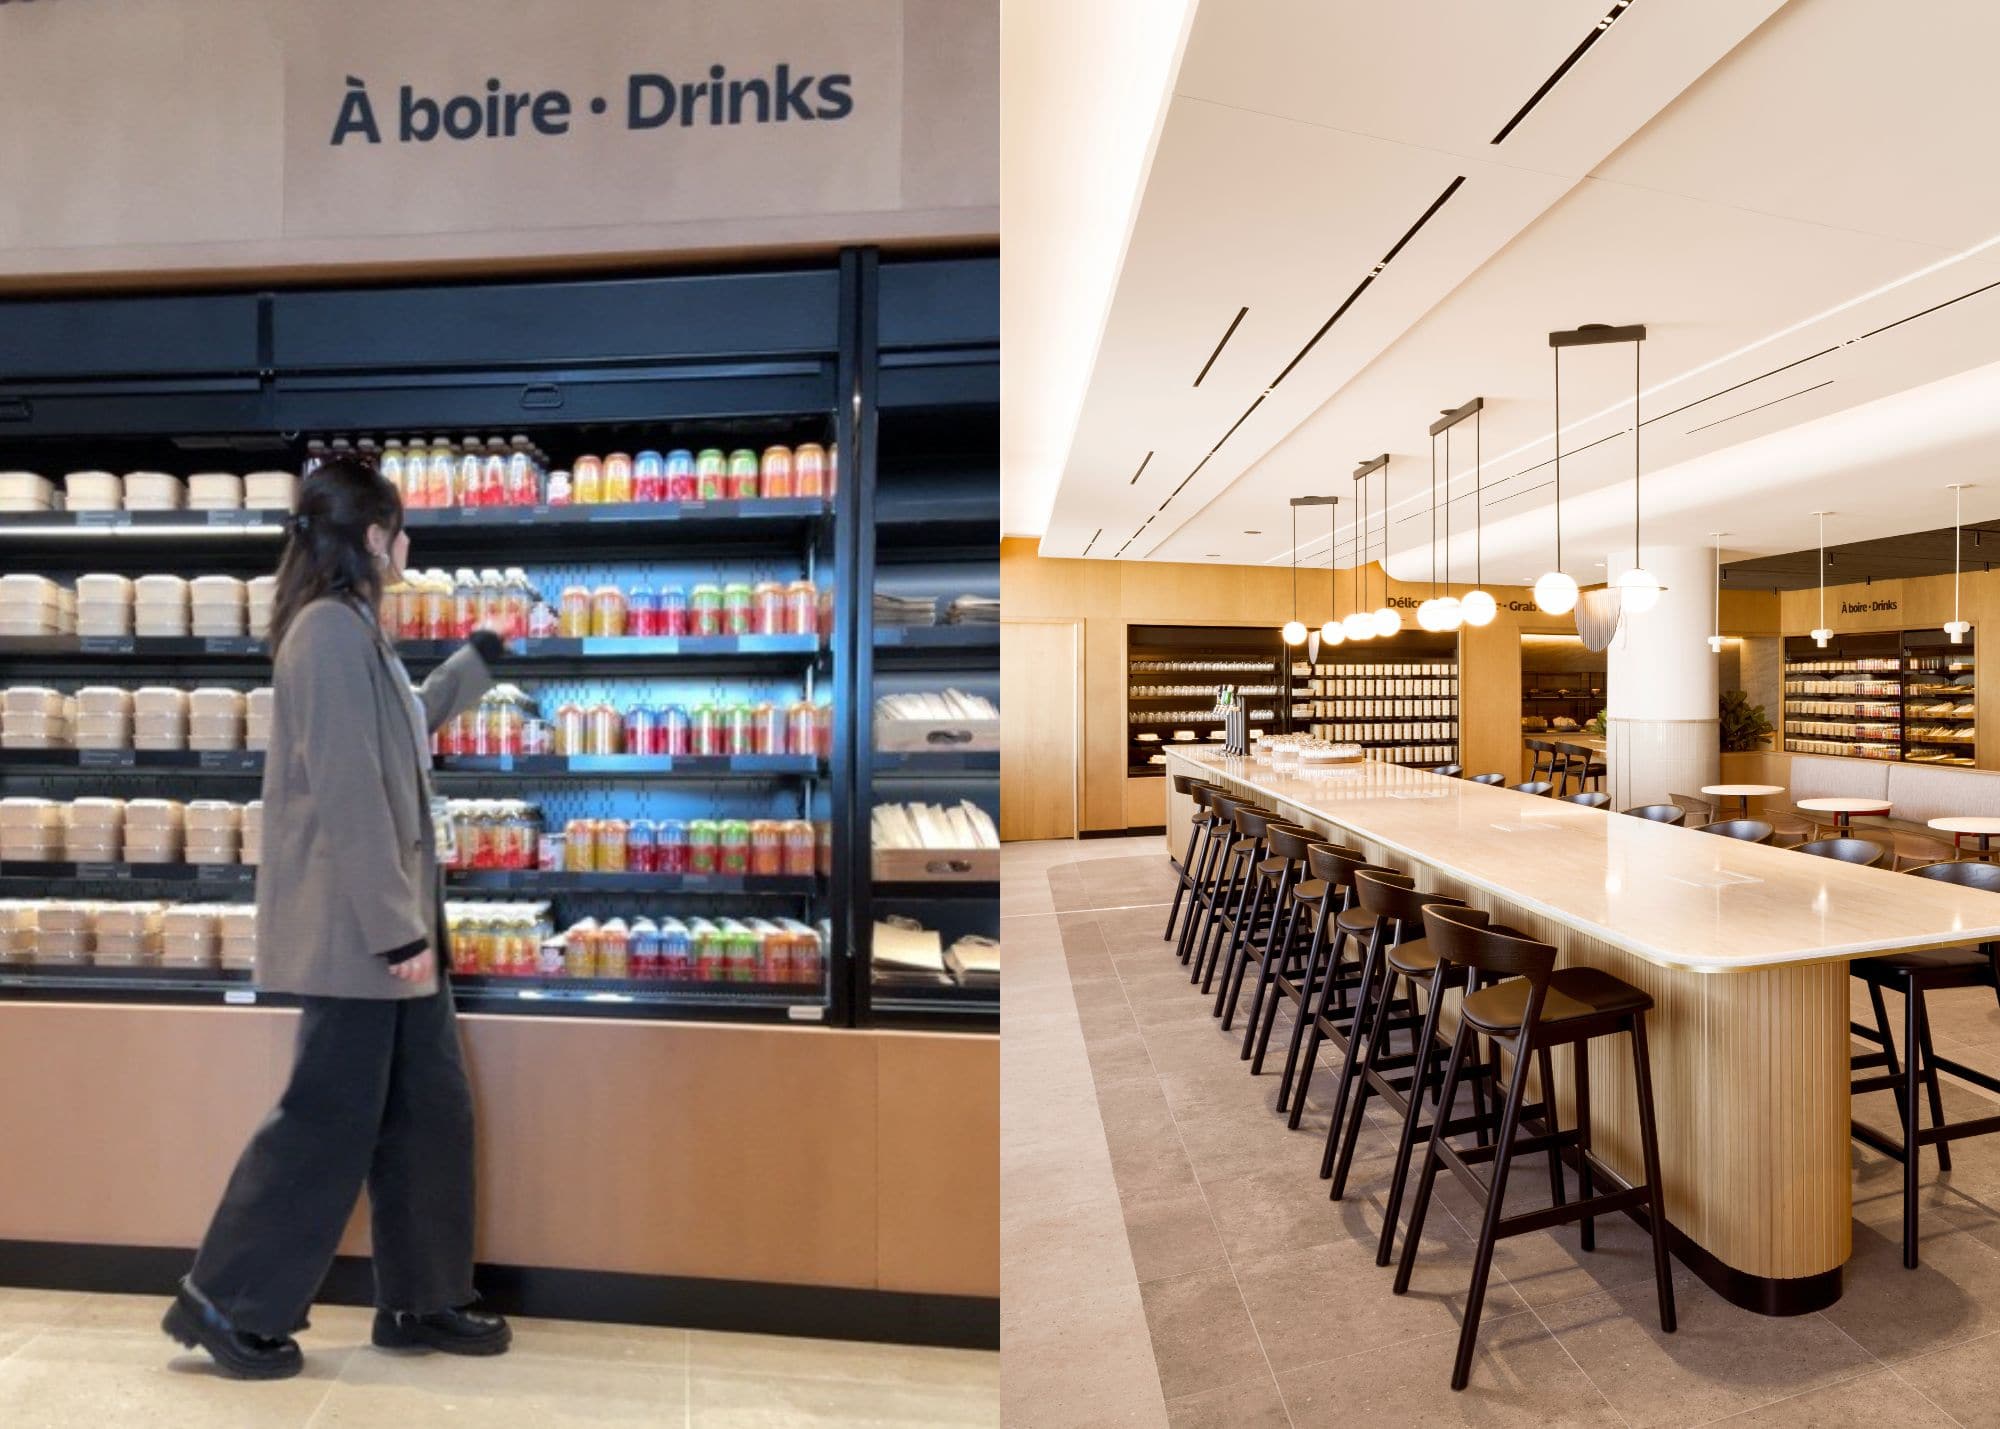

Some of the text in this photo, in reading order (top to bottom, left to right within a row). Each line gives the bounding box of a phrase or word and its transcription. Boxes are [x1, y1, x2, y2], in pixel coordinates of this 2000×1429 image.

[331, 75, 381, 145] À
[400, 78, 571, 141] boire
[627, 64, 853, 129] Drinks
[1509, 601, 1537, 612] Grab
[1841, 601, 1848, 614] À
[1848, 602, 1868, 613] boire
[1872, 599, 1897, 611] Drinks
